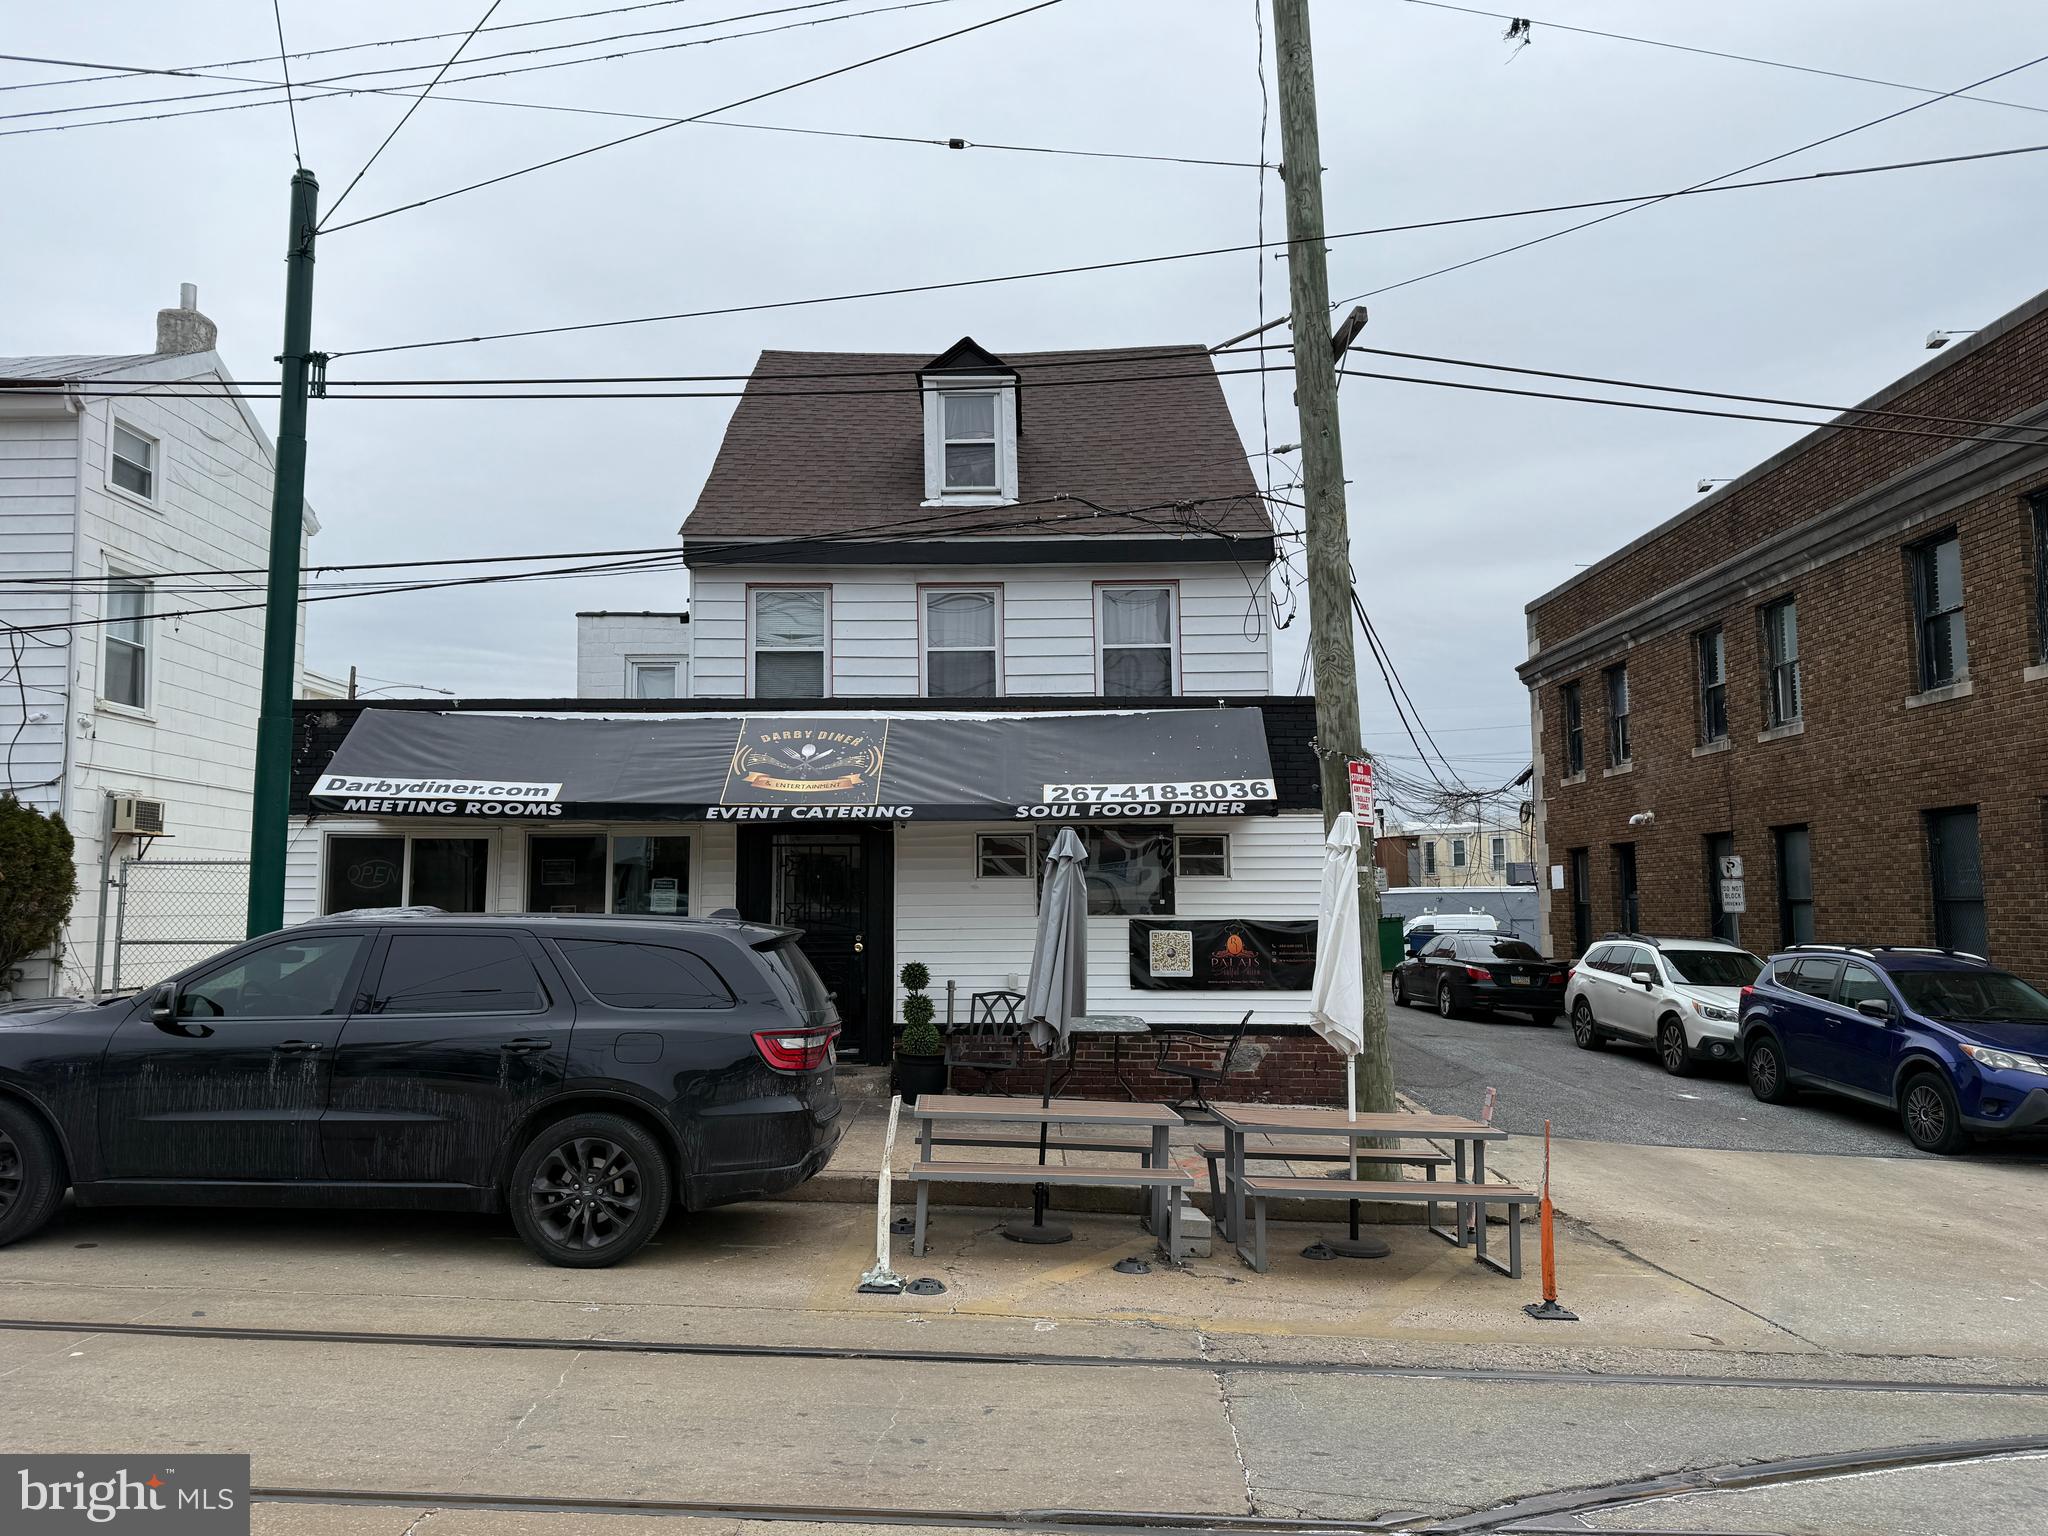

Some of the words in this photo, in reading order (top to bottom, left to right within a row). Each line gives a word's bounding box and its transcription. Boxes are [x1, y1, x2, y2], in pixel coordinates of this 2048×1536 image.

[760, 730, 812, 743] DARBY
[817, 731, 864, 747] DINER
[325, 777, 550, 799] Darbydiner.com
[775, 781, 841, 790] ENTERTAINMENT
[1051, 780, 1270, 802] 267-418-8036
[343, 798, 459, 814] MEETING
[465, 800, 563, 816] ROOMS
[705, 805, 786, 820] EVENT
[789, 803, 914, 819] CATERING
[1015, 803, 1081, 818] SOUL
[1088, 802, 1162, 817] FOOD
[1168, 802, 1247, 815] DINER
[347, 864, 400, 883] OPEN
[1211, 957, 1260, 967] PALAIS
